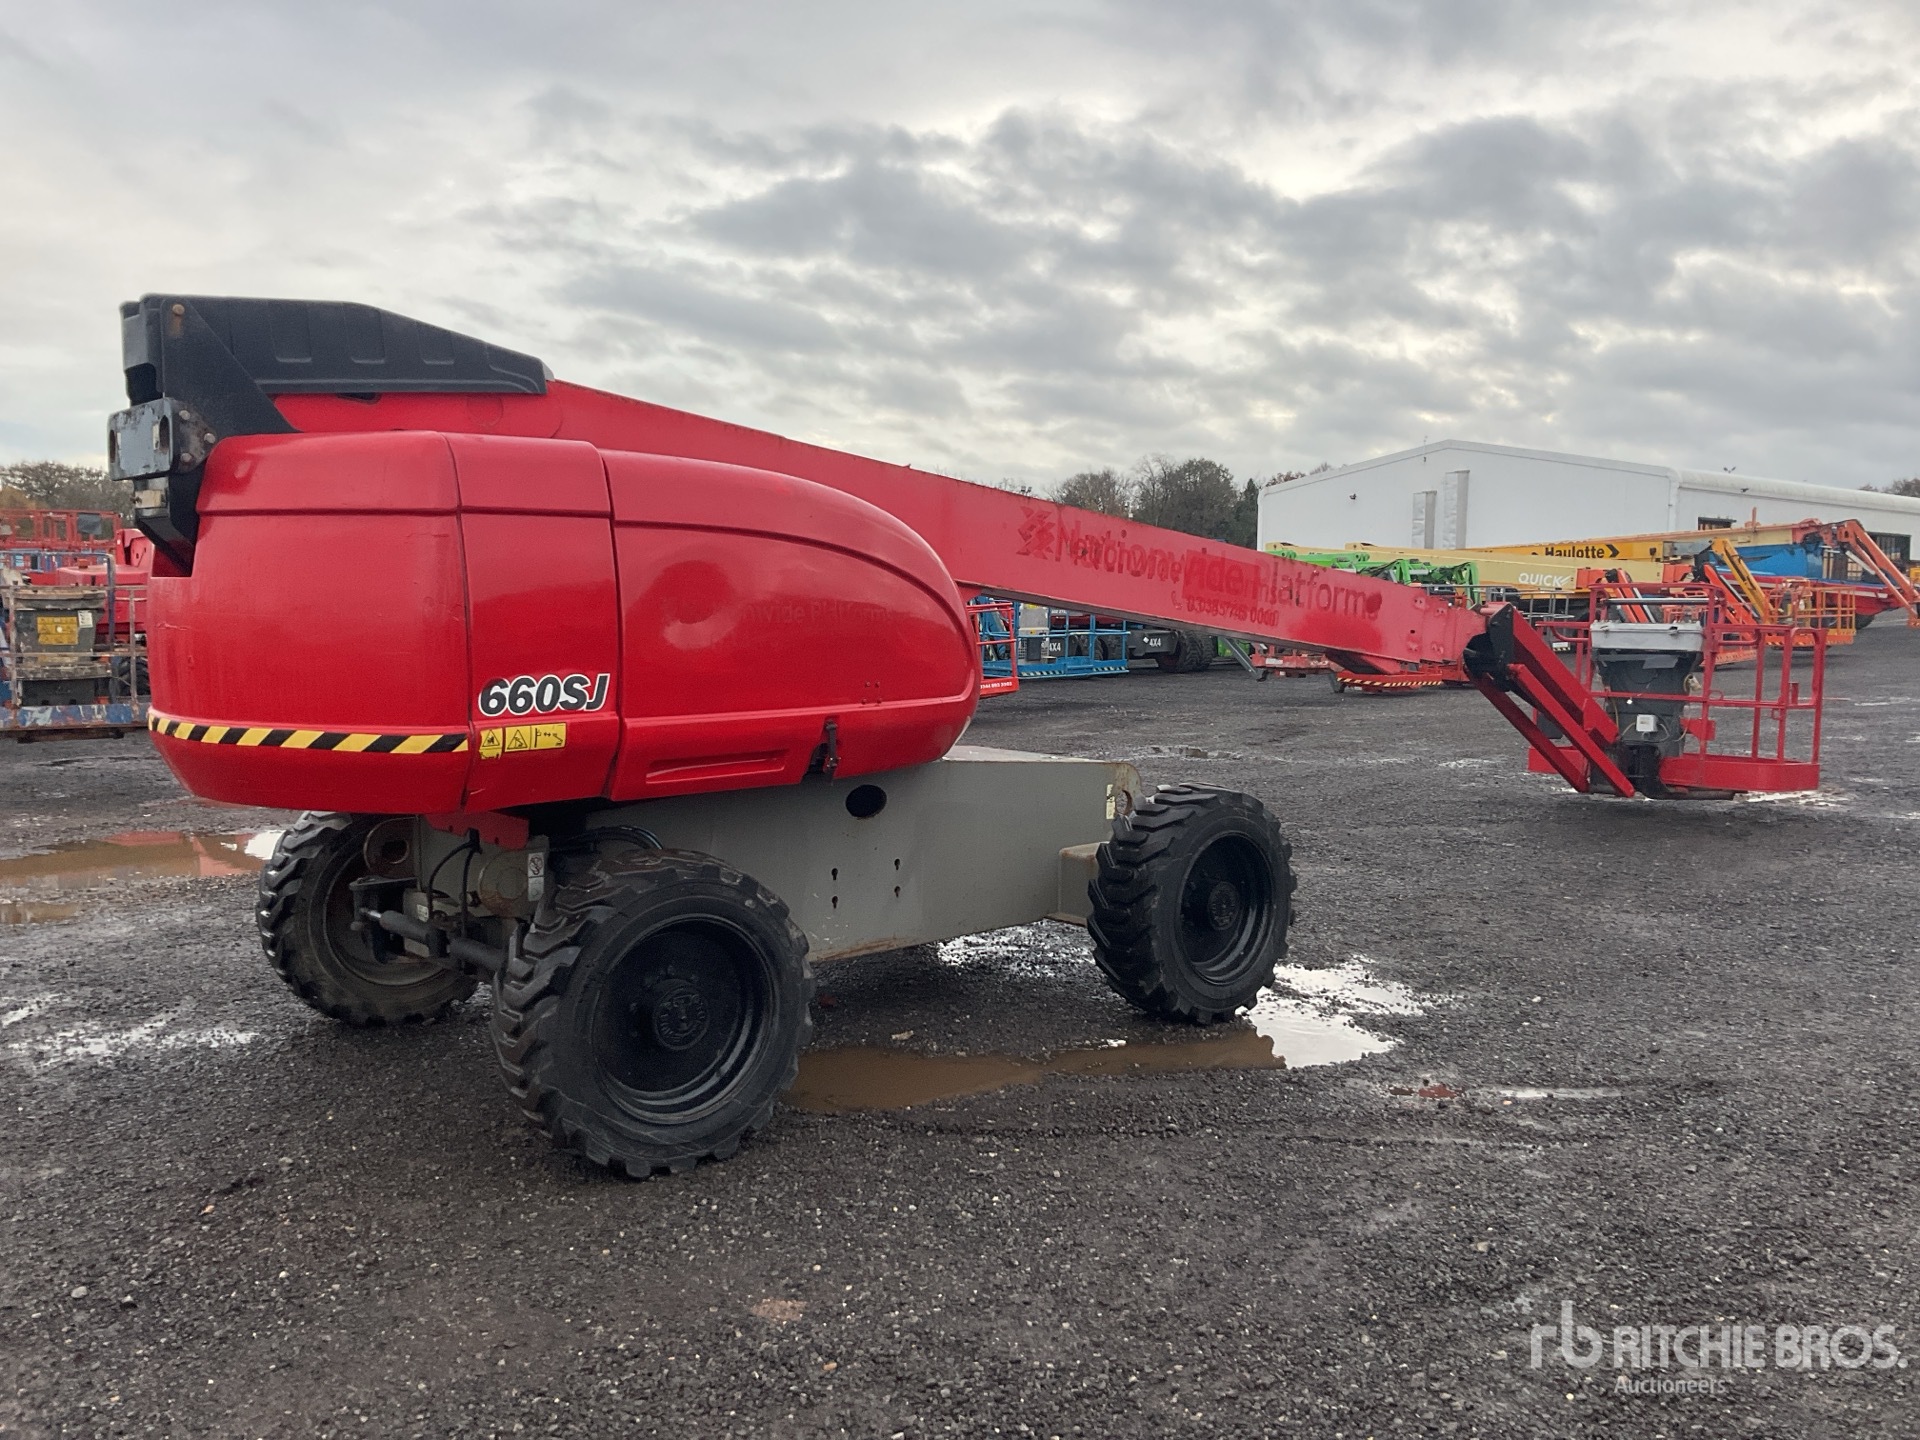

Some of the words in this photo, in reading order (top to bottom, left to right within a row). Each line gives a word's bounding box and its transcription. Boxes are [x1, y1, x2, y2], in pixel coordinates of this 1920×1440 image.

[1545, 545, 1605, 559] Haulotte
[1518, 572, 1561, 586] QUICK
[1148, 638, 1162, 647] 4X4
[478, 673, 611, 717] 660SJ
